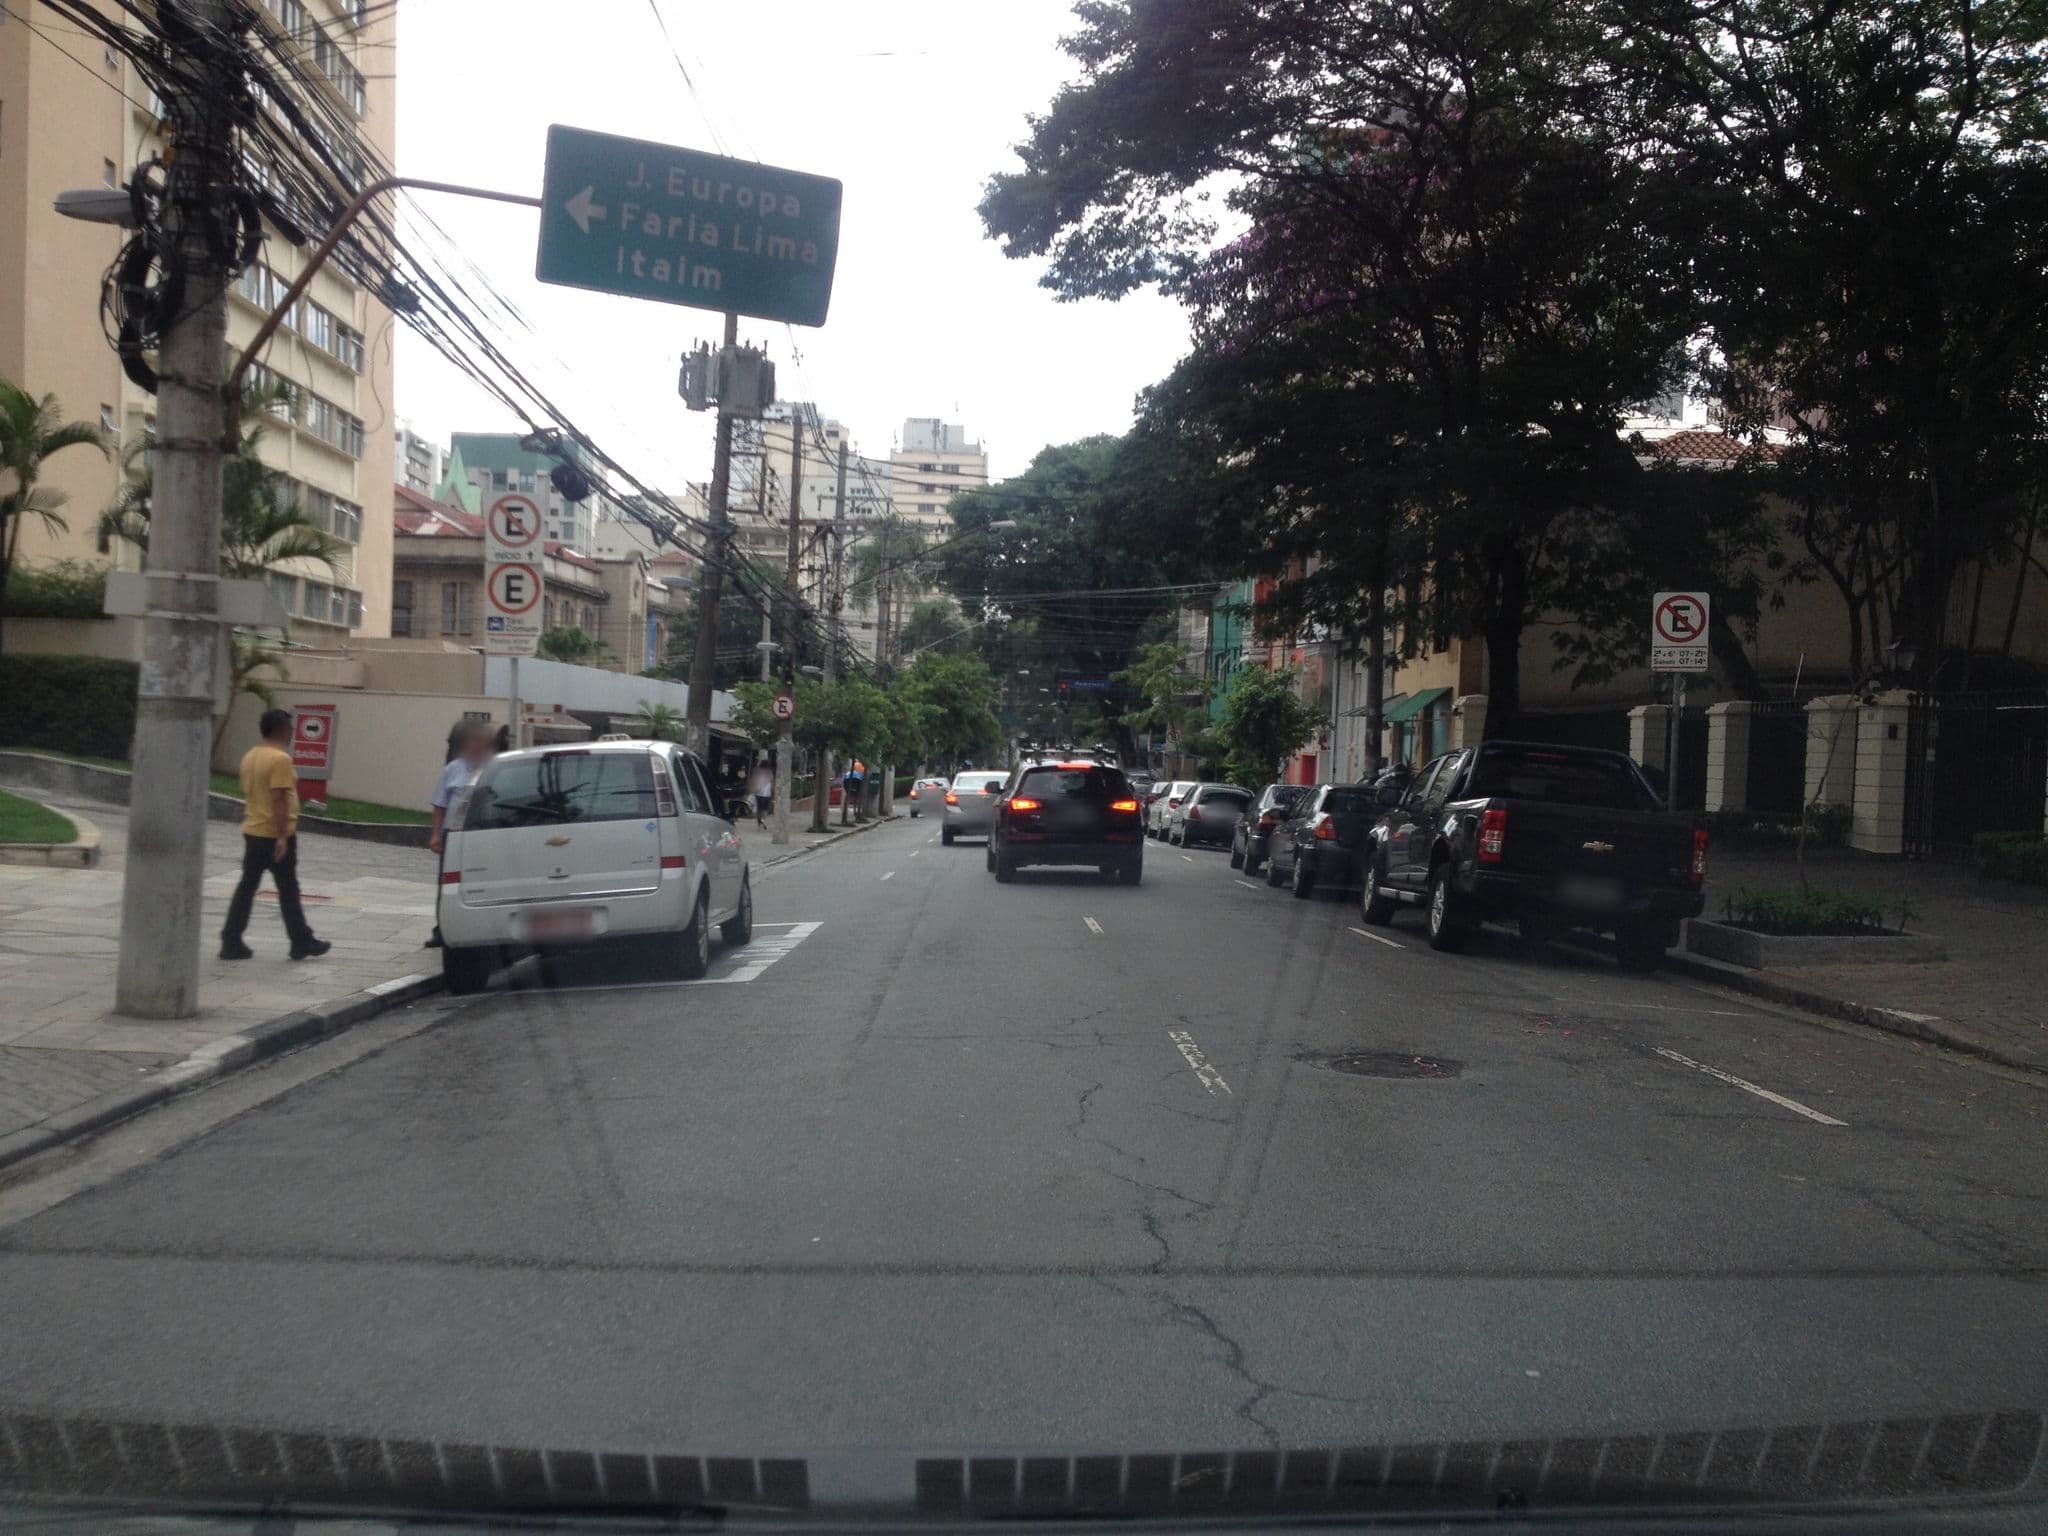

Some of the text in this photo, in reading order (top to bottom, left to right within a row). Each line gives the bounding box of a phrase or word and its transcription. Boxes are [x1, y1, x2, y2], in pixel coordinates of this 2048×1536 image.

[626, 161, 801, 218] J. Europa
[621, 202, 818, 265] Faria Lima
[616, 245, 722, 291] Itaim
[505, 574, 524, 604] E
